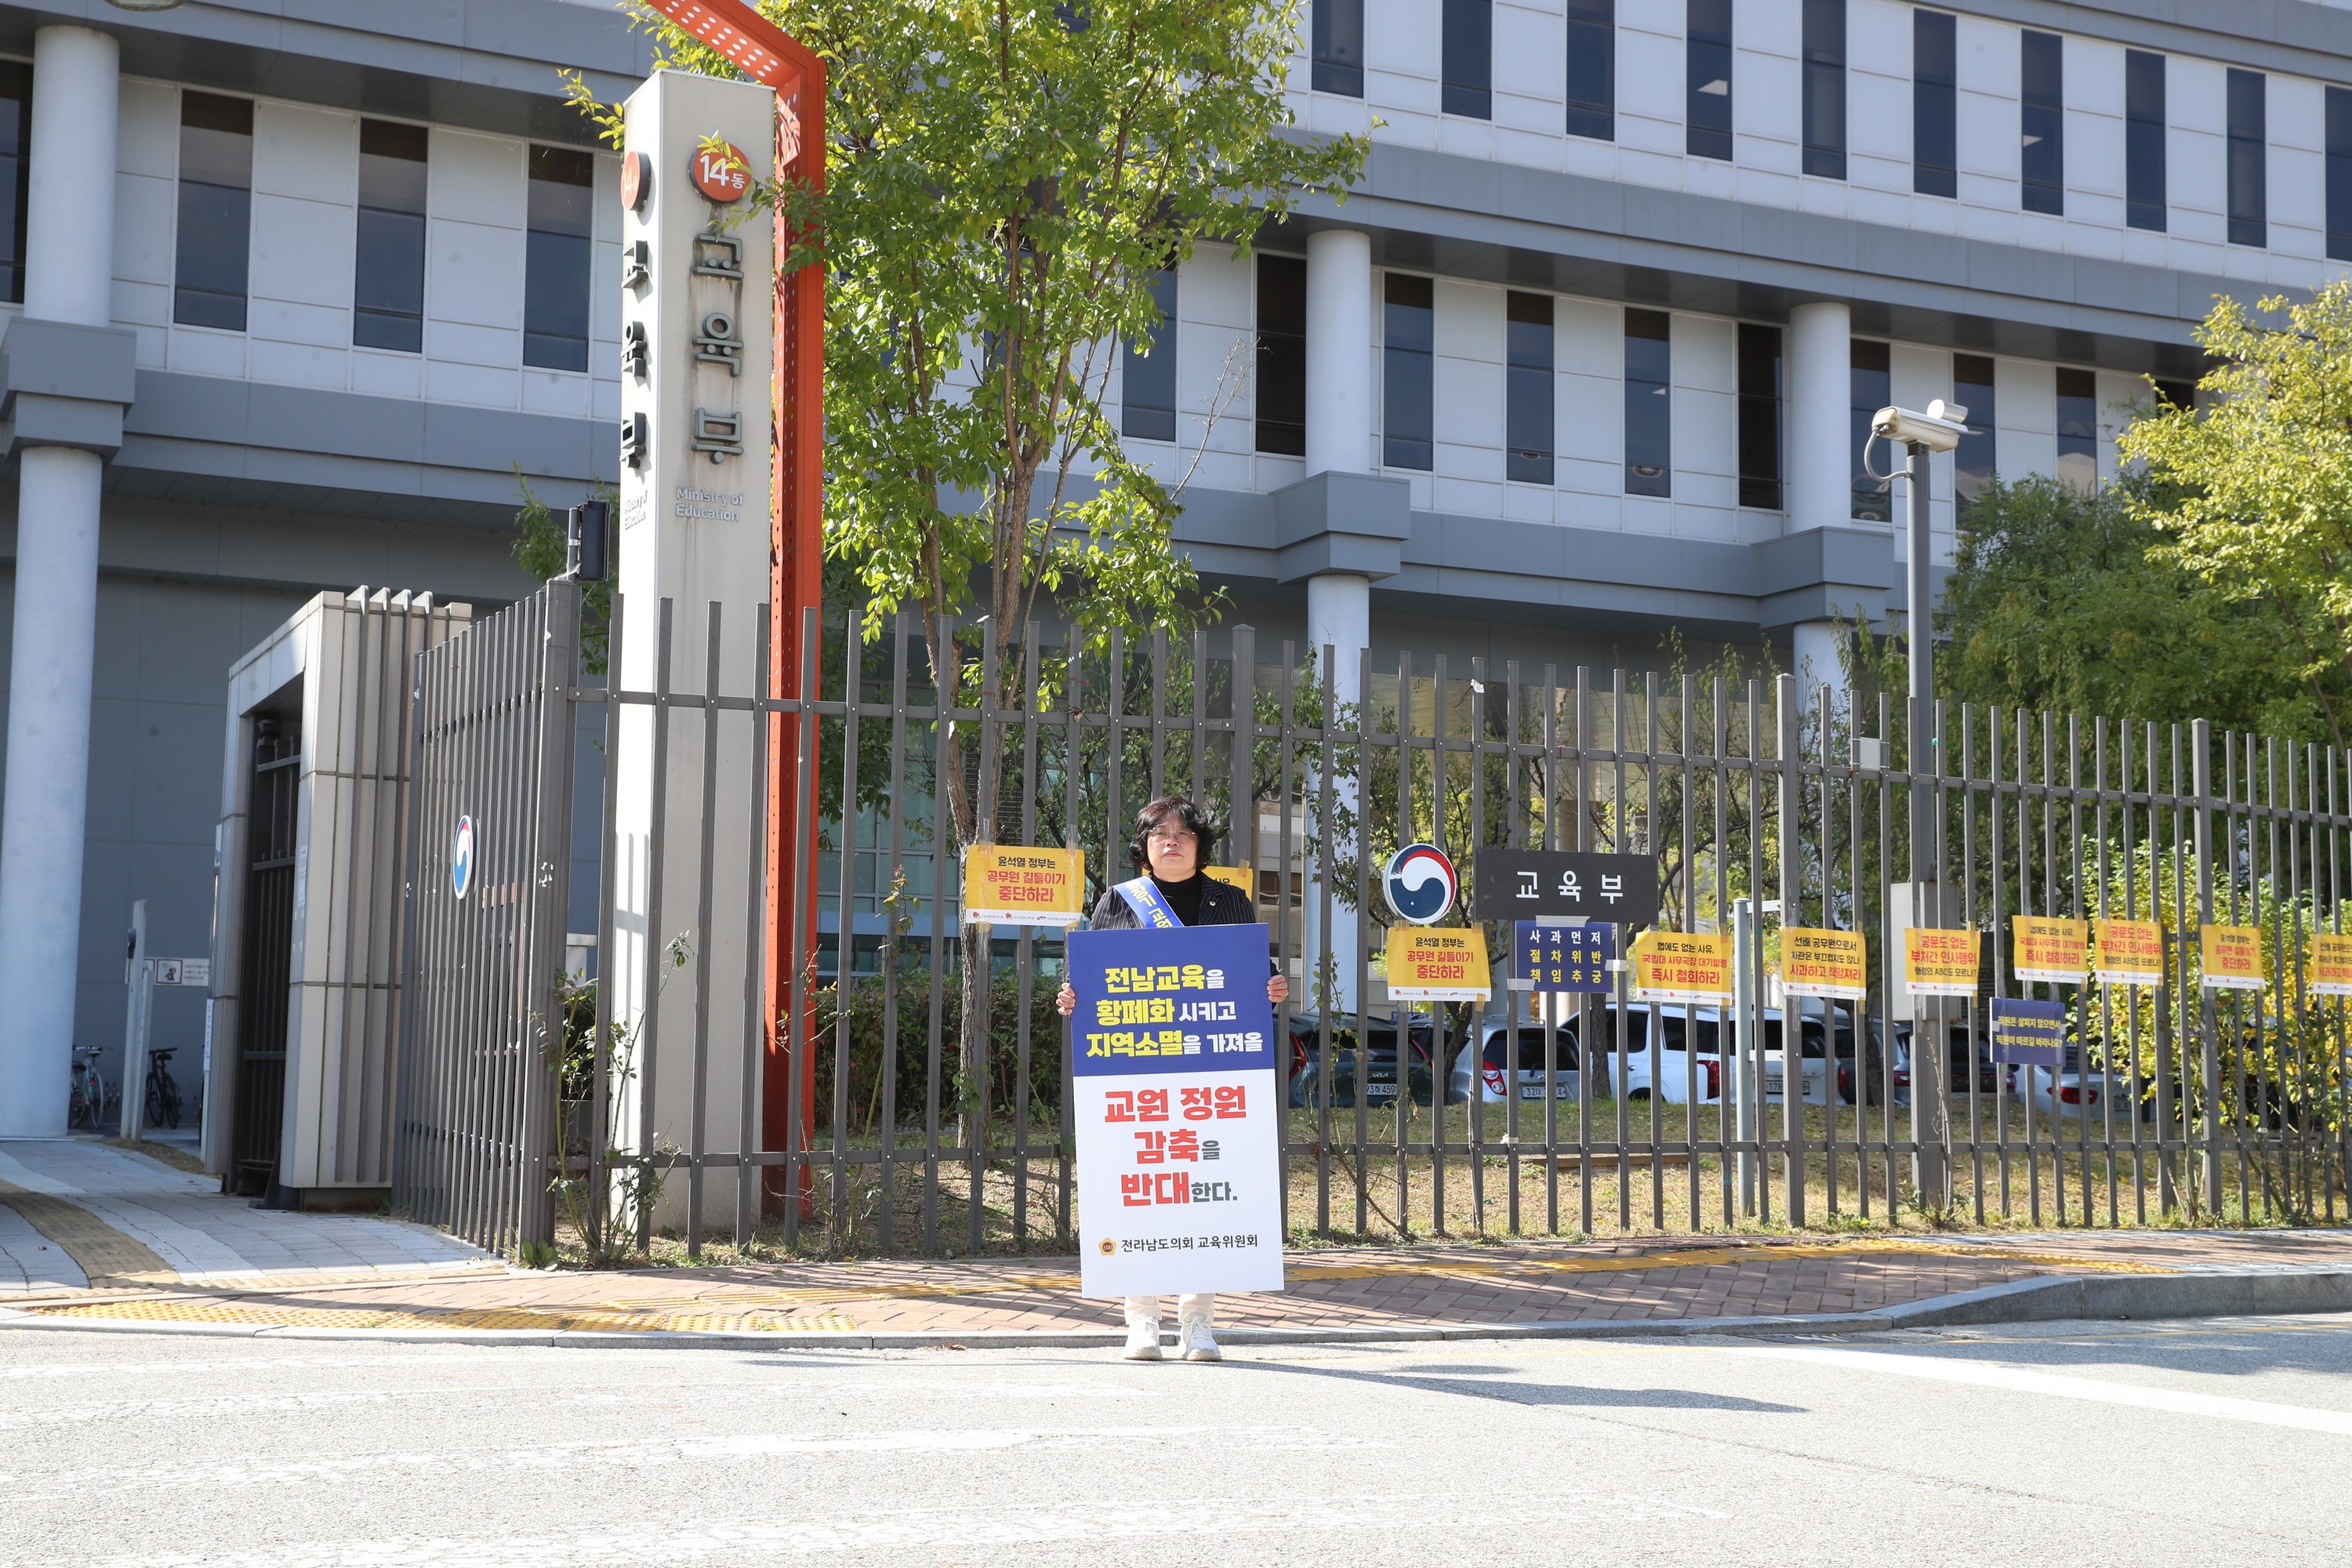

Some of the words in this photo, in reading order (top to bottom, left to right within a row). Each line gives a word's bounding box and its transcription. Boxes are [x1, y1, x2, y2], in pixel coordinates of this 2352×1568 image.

[676, 487, 730, 506] Ministry
[731, 492, 744, 506] of
[676, 503, 739, 521] Education
[998, 856, 1025, 867] 윤석열
[1028, 858, 1055, 869] 정부는
[987, 870, 1019, 884] 공무원
[1023, 872, 1065, 885] 길들이기
[999, 886, 1054, 902] 중단하라
[2111, 927, 2134, 938] 공문도
[2137, 928, 2153, 940] 없는
[1415, 938, 1439, 947] 윤석열
[1442, 938, 1465, 947] 정부는
[1657, 942, 1679, 952] 법에도
[1682, 943, 1696, 953] 없는
[1795, 936, 1810, 947] 선배
[1813, 938, 1857, 951] 공무원으로서
[1922, 936, 1947, 948] 공문도
[1951, 937, 1967, 949] 없는
[2101, 940, 2125, 953] 부처간
[2129, 942, 2161, 955] 인사행위
[1407, 951, 1435, 961] 공무원
[1438, 952, 1473, 963] 길들이기
[1642, 954, 1666, 964] 국립대
[1668, 956, 1697, 966] 사무국장
[1699, 958, 1727, 967] 대기발령
[1791, 951, 1812, 960] 차관은
[1911, 950, 1938, 964] 부처간
[1941, 952, 1976, 964] 인사행위
[2027, 949, 2042, 962] 즉시
[2046, 951, 2079, 964] 철회하라
[2222, 957, 2250, 970] 중단하라
[1105, 964, 1225, 993] 전남교육을
[1417, 965, 1465, 979] 중단하라
[1651, 967, 1672, 982] 즉시
[1676, 969, 1720, 984] 철회하라
[1790, 964, 1826, 977] 사과하고
[1829, 967, 1860, 980] 책임져라
[1096, 998, 1174, 1026] 황폐화
[1178, 1001, 1236, 1022] 시키고
[1086, 1029, 1201, 1058] 지역소멸을
[1207, 1032, 1263, 1054] 가져올
[1104, 1088, 1170, 1123] 교원
[1180, 1085, 1247, 1120] 정원
[1134, 1128, 1220, 1164] 감축을
[1120, 1171, 1237, 1207] 반대한다.
[1121, 1237, 1193, 1253] 전라남도의회
[1198, 1234, 1258, 1249] 교육위원회
